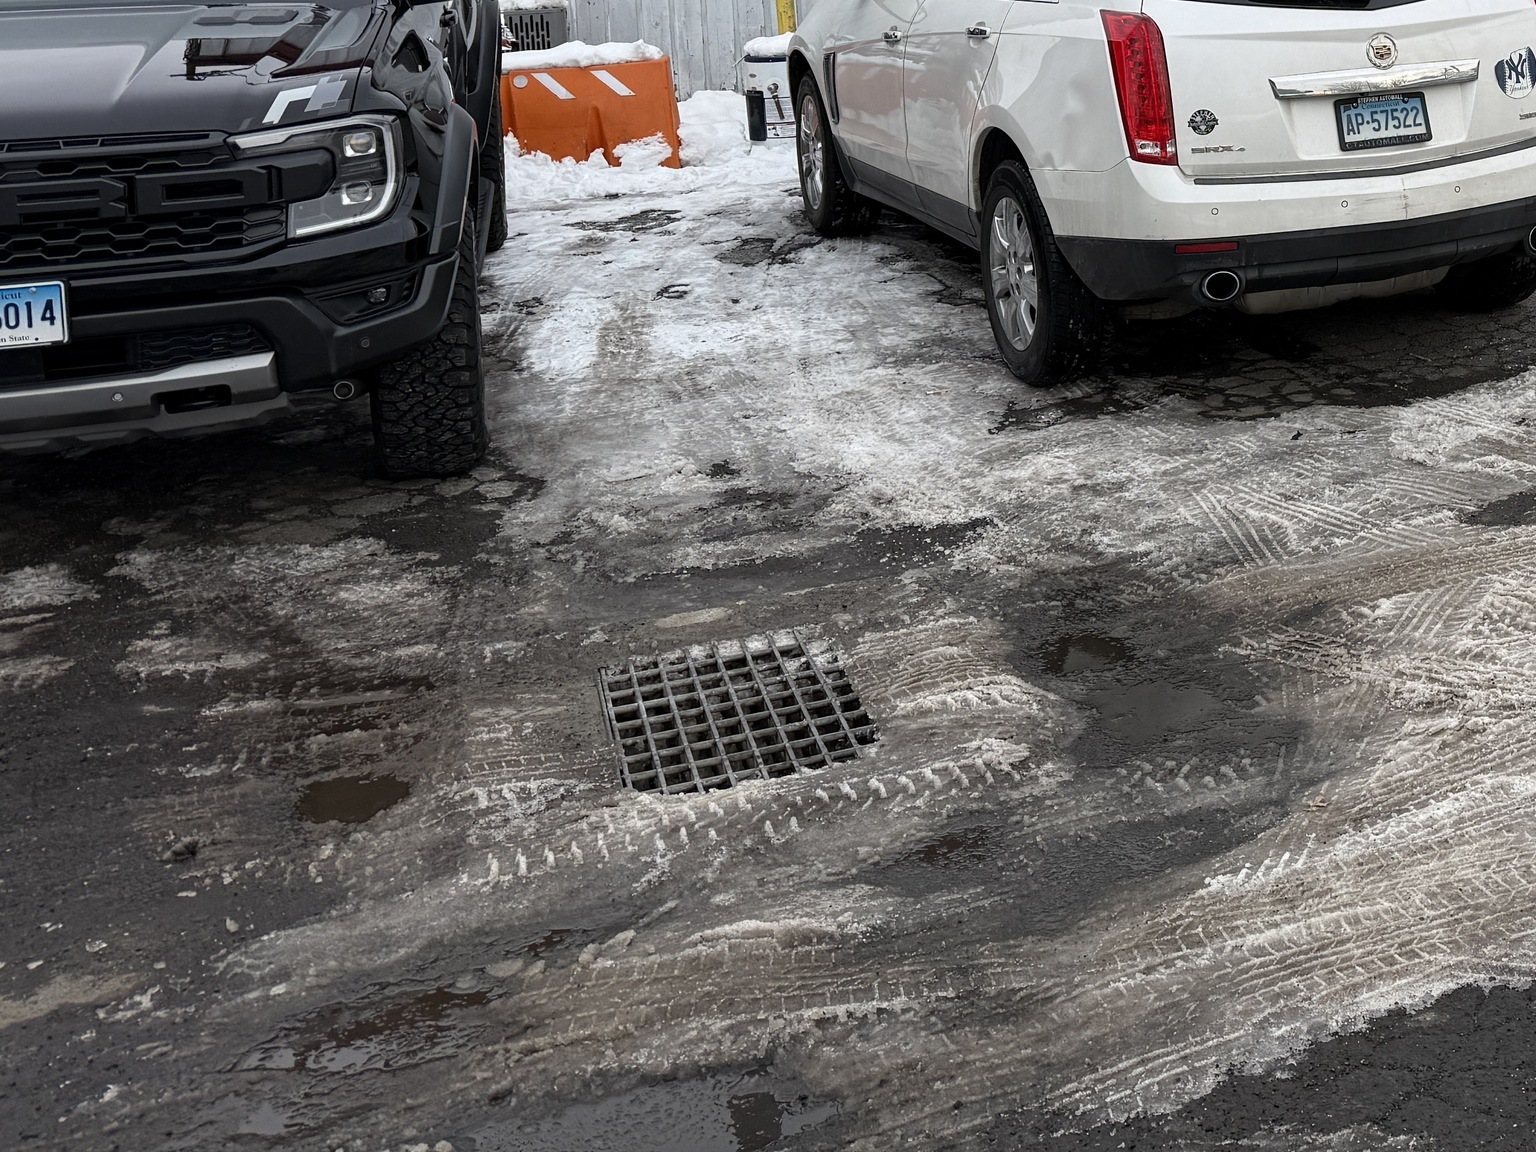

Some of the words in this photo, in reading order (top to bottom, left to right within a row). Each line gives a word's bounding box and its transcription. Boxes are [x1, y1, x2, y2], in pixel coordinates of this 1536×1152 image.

[1361, 101, 1400, 110] Connecticut
[0, 298, 56, 330] 014
[8, 334, 30, 342] State
